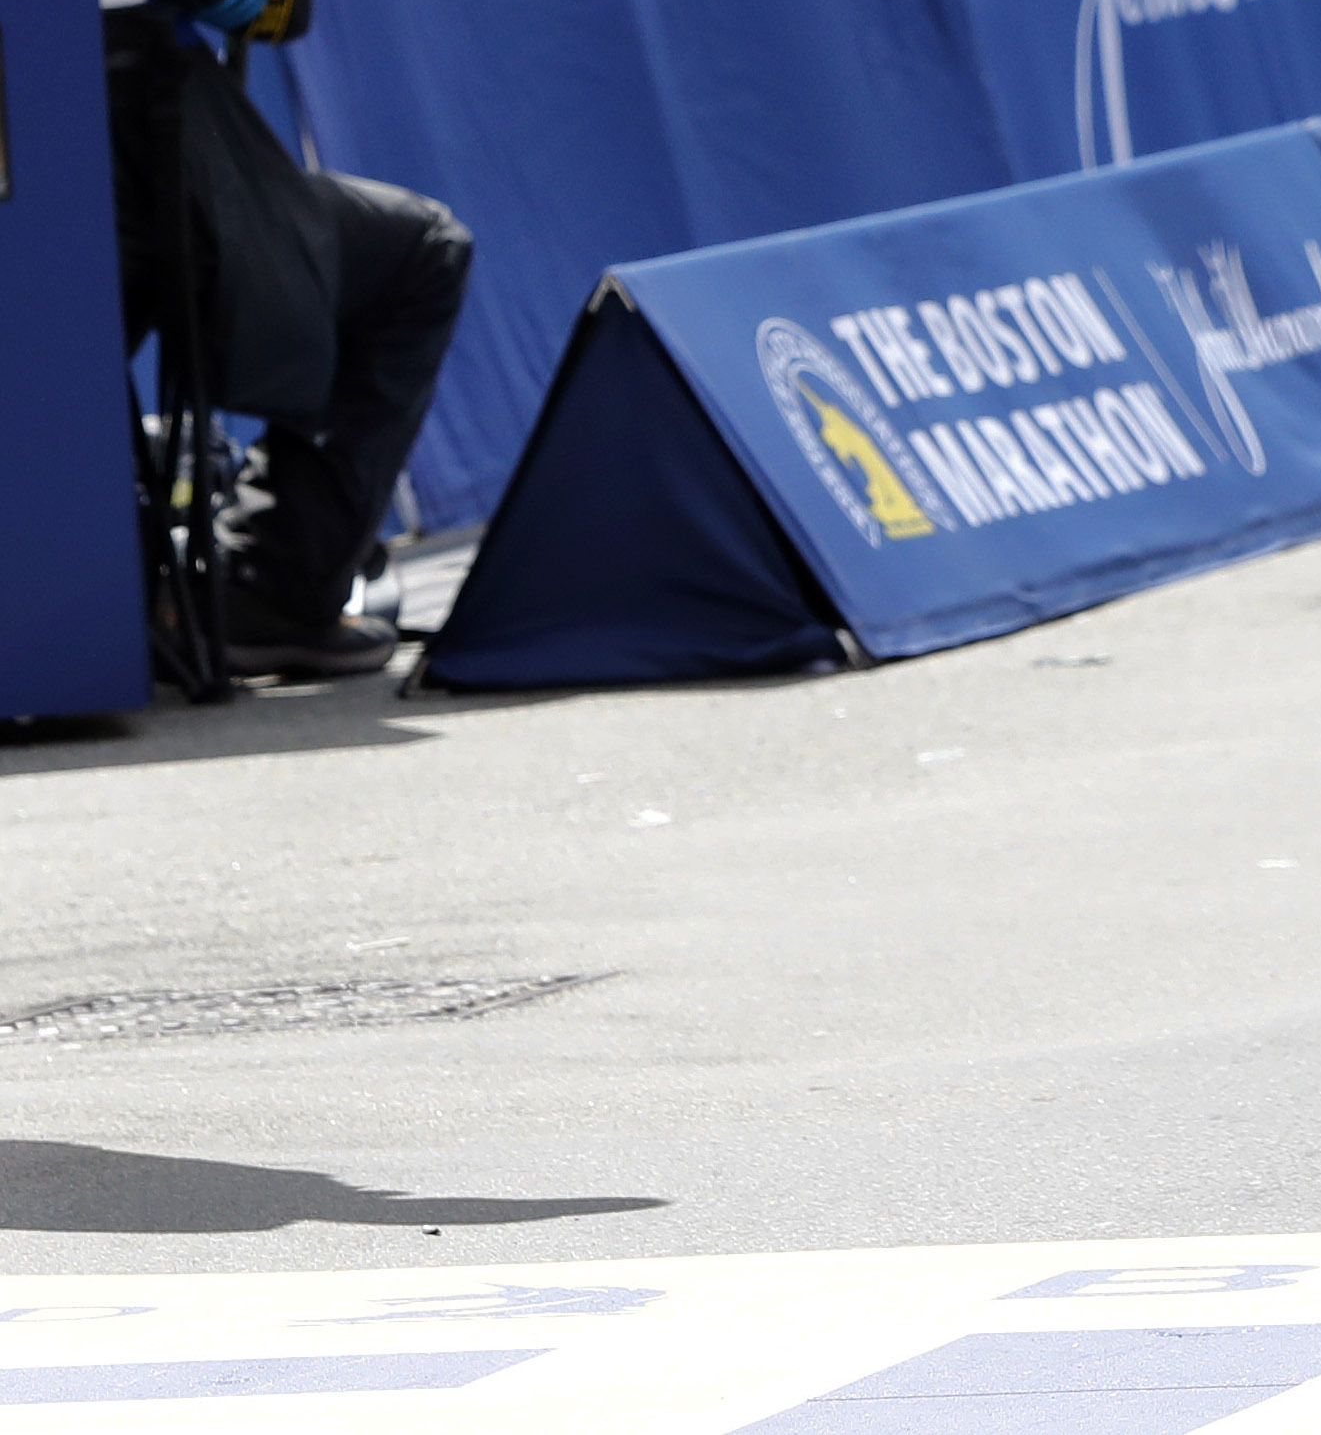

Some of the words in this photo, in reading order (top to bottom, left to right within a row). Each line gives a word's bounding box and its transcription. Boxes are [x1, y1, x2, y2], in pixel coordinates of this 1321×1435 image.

[830, 305, 954, 409] THE
[916, 272, 1127, 395] BOSTON
[907, 382, 1206, 528] MARATHON
